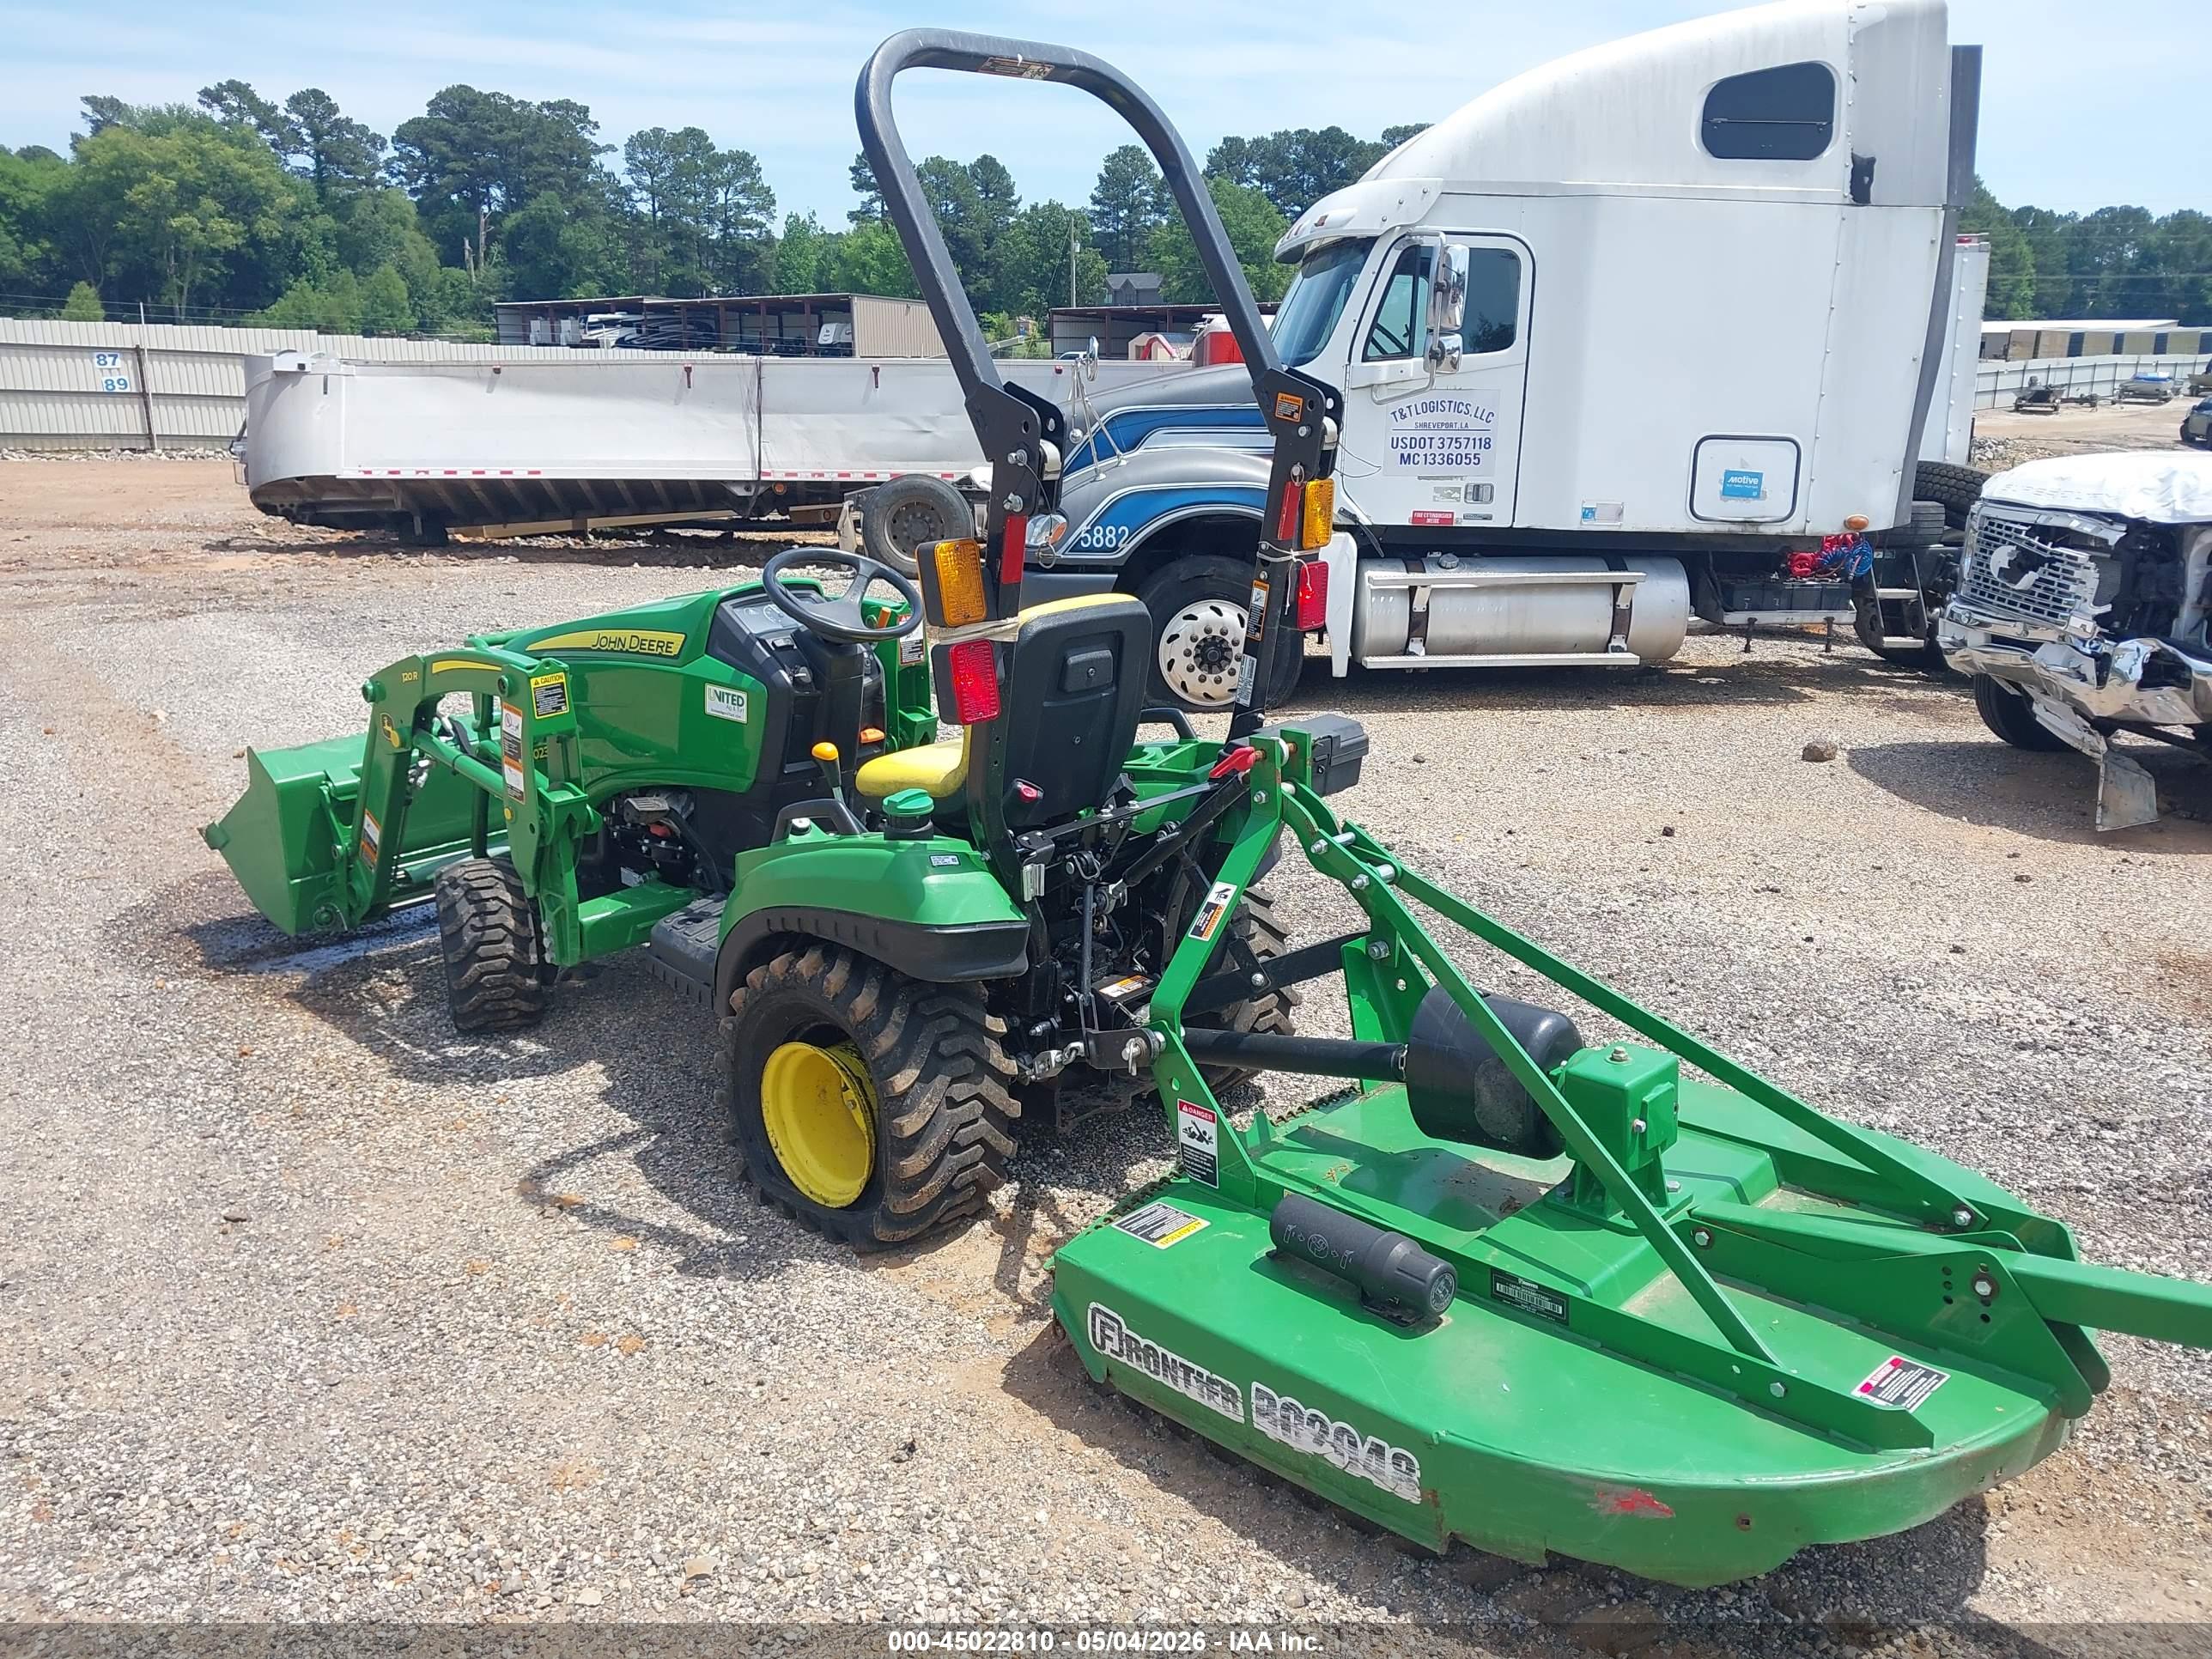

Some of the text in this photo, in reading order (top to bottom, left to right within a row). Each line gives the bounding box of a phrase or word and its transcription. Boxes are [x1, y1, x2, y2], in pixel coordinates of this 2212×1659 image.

[95, 353, 118, 366] 87
[104, 378, 128, 392] 89
[1391, 436, 1492, 450] USDOT 3757118
[1400, 453, 1480, 465] MC 1336055
[1727, 475, 1759, 485] Motive
[1080, 526, 1129, 548] 5882
[591, 633, 674, 653] JOHN DEERE
[540, 674, 563, 684] CAUTION
[708, 687, 744, 708] UNITED
[1188, 1106, 1213, 1121] DANGER
[1089, 1304, 1243, 1419] FRONTIER
